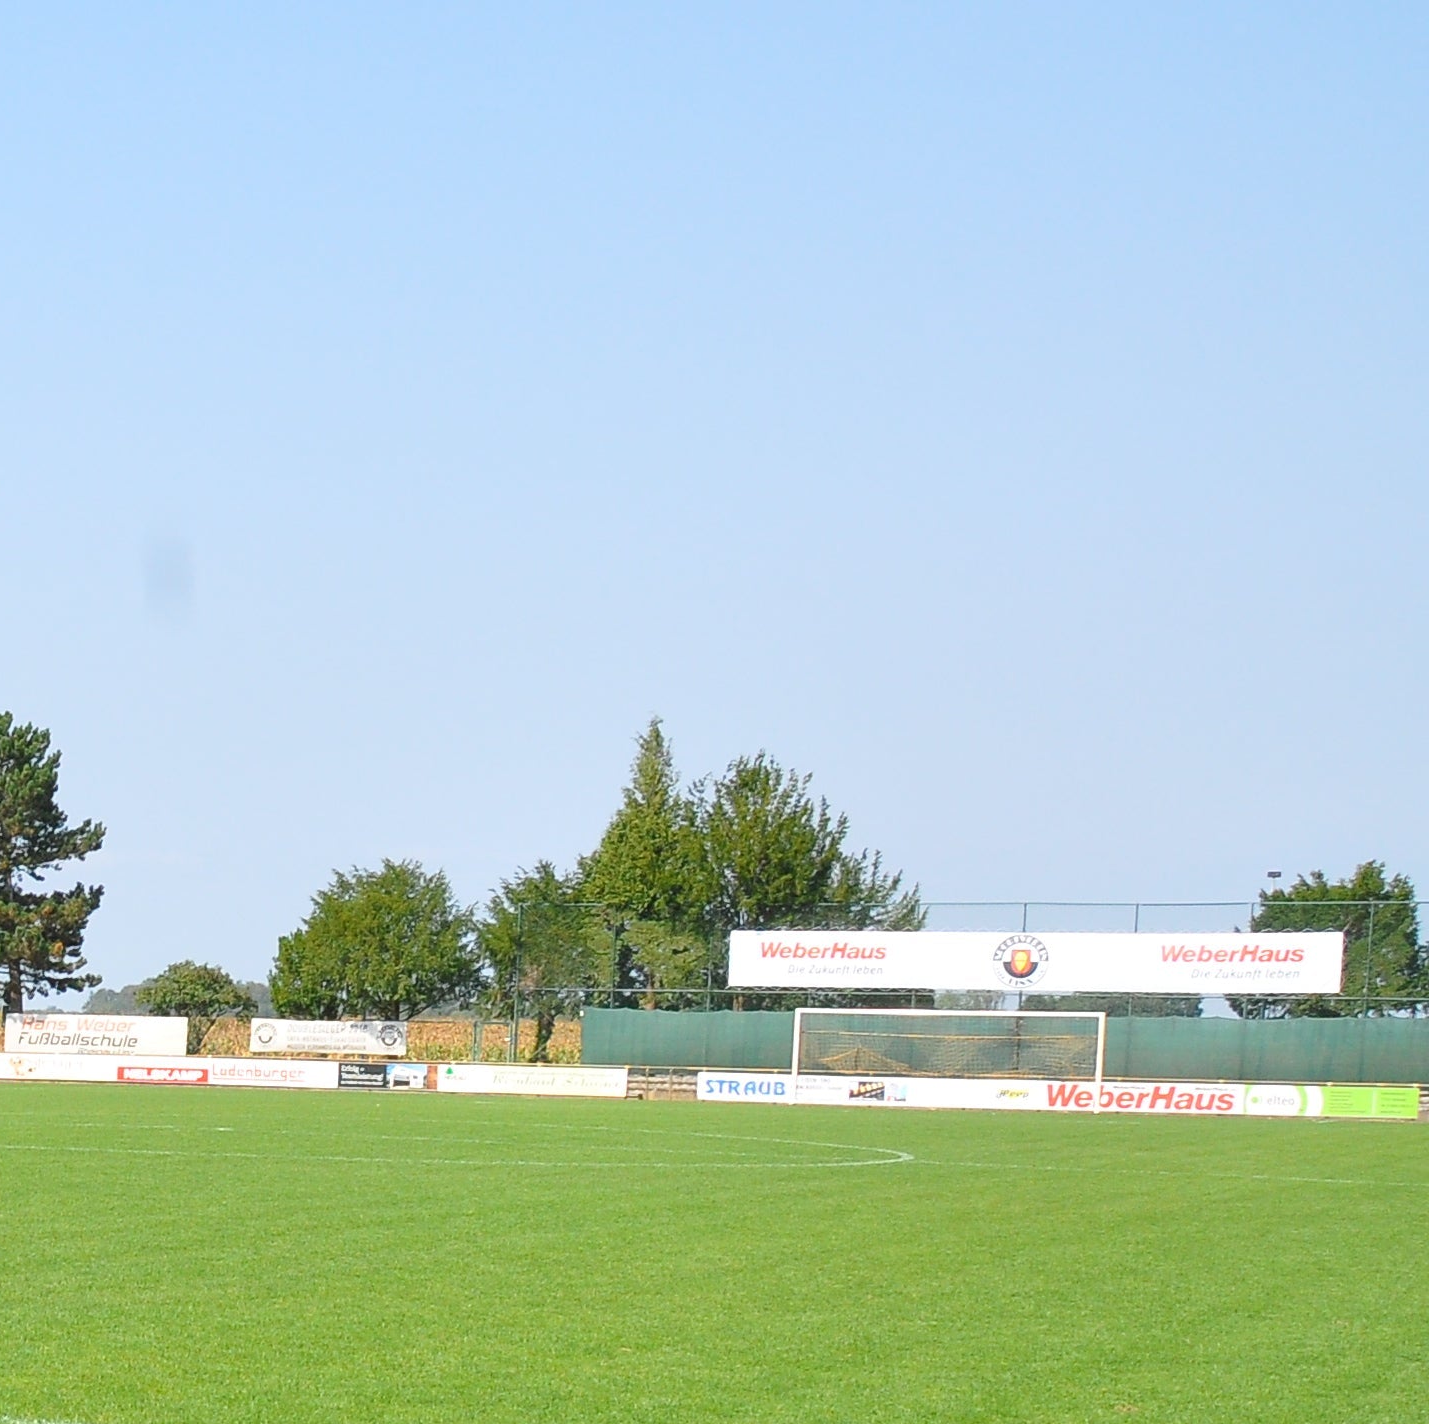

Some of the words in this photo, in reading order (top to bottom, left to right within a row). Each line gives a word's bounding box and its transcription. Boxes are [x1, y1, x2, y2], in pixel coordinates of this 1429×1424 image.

[760, 942, 887, 959] WeberHaus
[1161, 945, 1305, 962] WeberHaus
[788, 964, 806, 974] Die
[852, 965, 883, 974] leben
[1191, 969, 1210, 979] Die
[1214, 969, 1262, 980] Zukunft
[1265, 969, 1300, 979] leben
[21, 1016, 68, 1030] Hans
[77, 1018, 136, 1032] Weber
[18, 1032, 138, 1048] Fußballschule
[706, 1079, 786, 1096] STRAUB
[1047, 1084, 1235, 1111] WeberHaus
